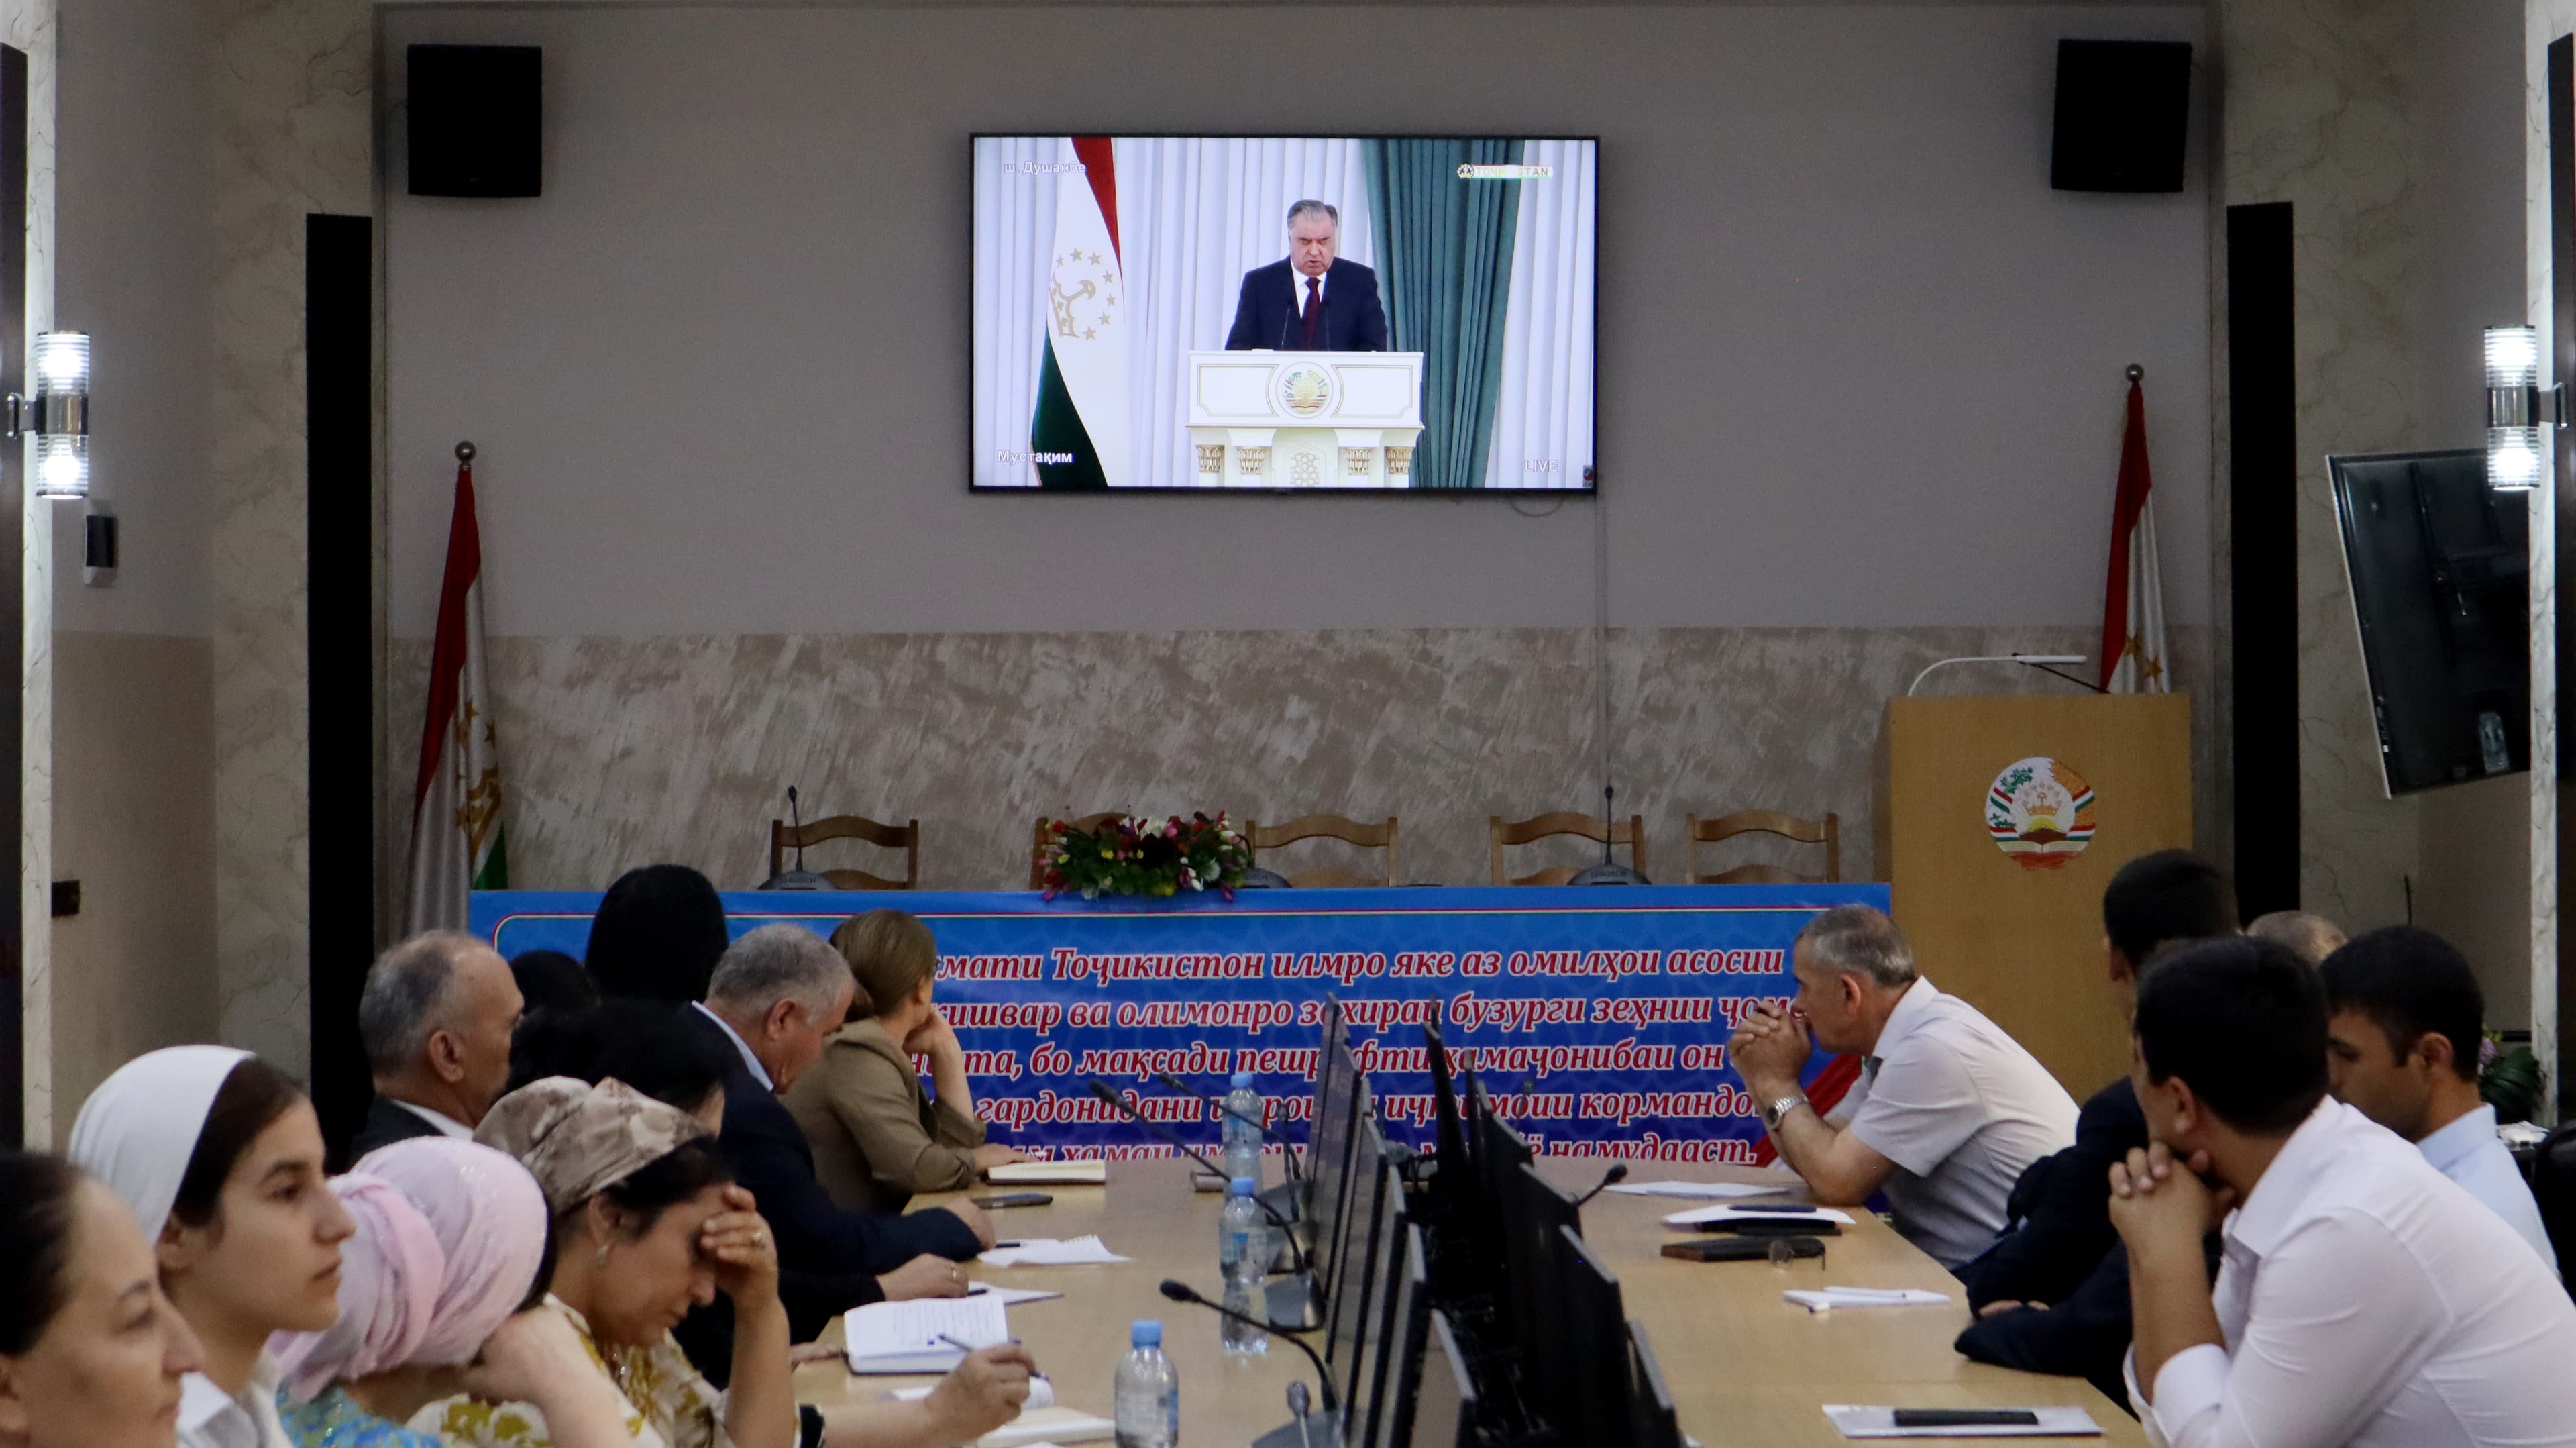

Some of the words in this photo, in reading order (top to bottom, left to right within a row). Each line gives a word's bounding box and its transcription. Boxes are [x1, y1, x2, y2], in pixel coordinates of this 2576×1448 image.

[1004, 164, 1019, 172] ш.
[1023, 161, 1087, 175] Душанбе
[997, 450, 1073, 465] Мустақим
[1524, 460, 1559, 472] LIVE
[935, 955, 1043, 980] мати
[1052, 947, 1265, 987] Тоҷикистон
[1272, 953, 1387, 986] илмро
[1389, 951, 1454, 978] яке
[1460, 951, 1502, 977] аз
[1508, 950, 1661, 982] омилҳои
[1667, 949, 1784, 974] асосии
[1067, 1002, 1111, 1028] ва
[1116, 1000, 1293, 1035] олимонро
[1297, 999, 1444, 1034] зхираи
[1450, 990, 1587, 1033] бузурги
[1590, 997, 1713, 1030] зеҳнии
[1030, 1042, 1072, 1076] бо
[1075, 1041, 1230, 1082] мақсади
[1234, 1039, 1432, 1082] пешрфти
[1681, 1045, 1725, 1070] он
[975, 1089, 1205, 1132] гардонидани
[1578, 1084, 1760, 1126] кормандо
